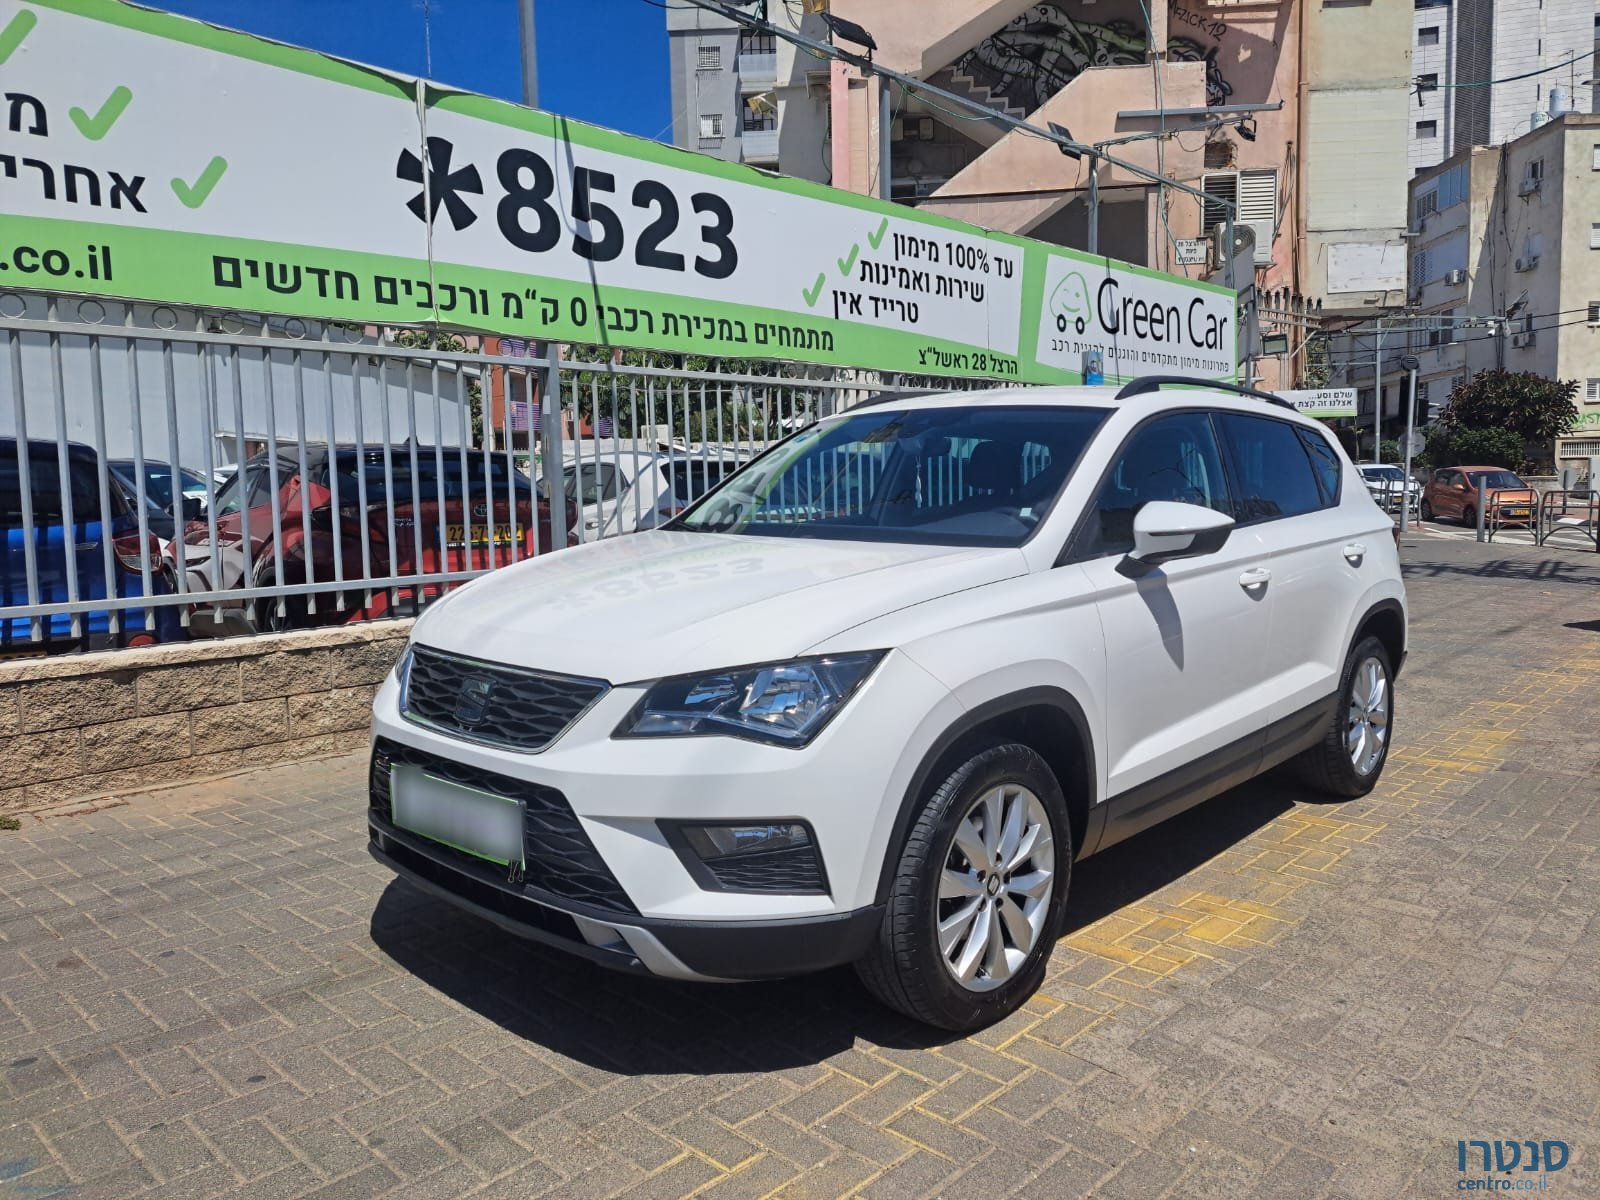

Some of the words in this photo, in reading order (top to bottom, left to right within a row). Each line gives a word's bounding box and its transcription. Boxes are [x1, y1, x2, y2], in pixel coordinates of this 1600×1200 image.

[893, 232, 939, 262] מימון
[946, 242, 990, 274] 100%
[213, 255, 359, 301] חדשים
[860, 260, 930, 293] ואמינות
[994, 256, 1013, 279] עד
[374, 275, 489, 316] ורכבים
[936, 275, 984, 303] שירות
[596, 304, 654, 334] רכבי
[832, 290, 862, 319] אין
[869, 295, 919, 323] טרייד
[1097, 277, 1181, 344] Green
[1188, 297, 1227, 350] Car
[662, 312, 748, 343] במכירת
[755, 322, 834, 351] מתמחים
[1051, 339, 1070, 352] רכב
[972, 352, 987, 371] 28
[990, 354, 1018, 375] הרצל
[1333, 391, 1352, 399] שלם
